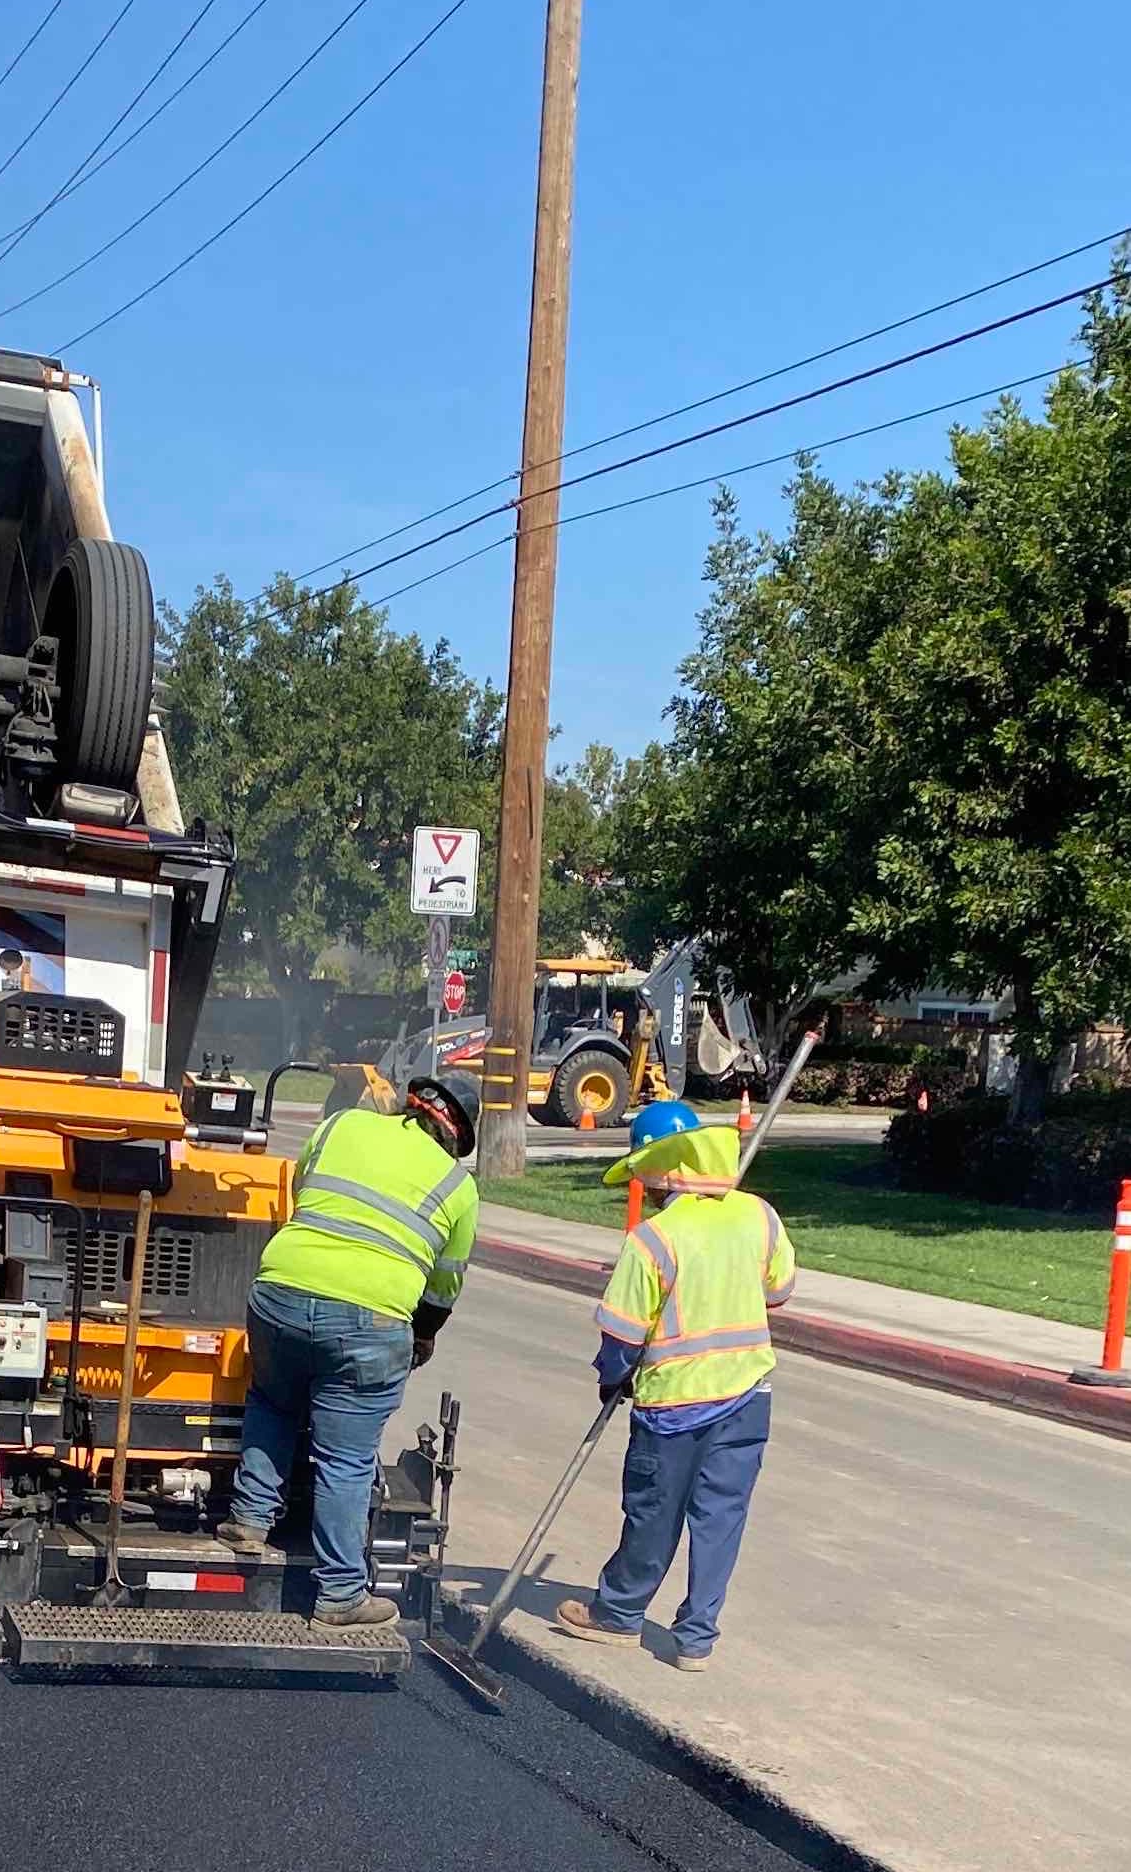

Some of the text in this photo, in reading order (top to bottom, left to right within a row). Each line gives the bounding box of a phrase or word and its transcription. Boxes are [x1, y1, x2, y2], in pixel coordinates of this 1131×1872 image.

[455, 888, 467, 898] TO
[445, 984, 465, 1000] STOP
[670, 993, 684, 1046] DEERE
